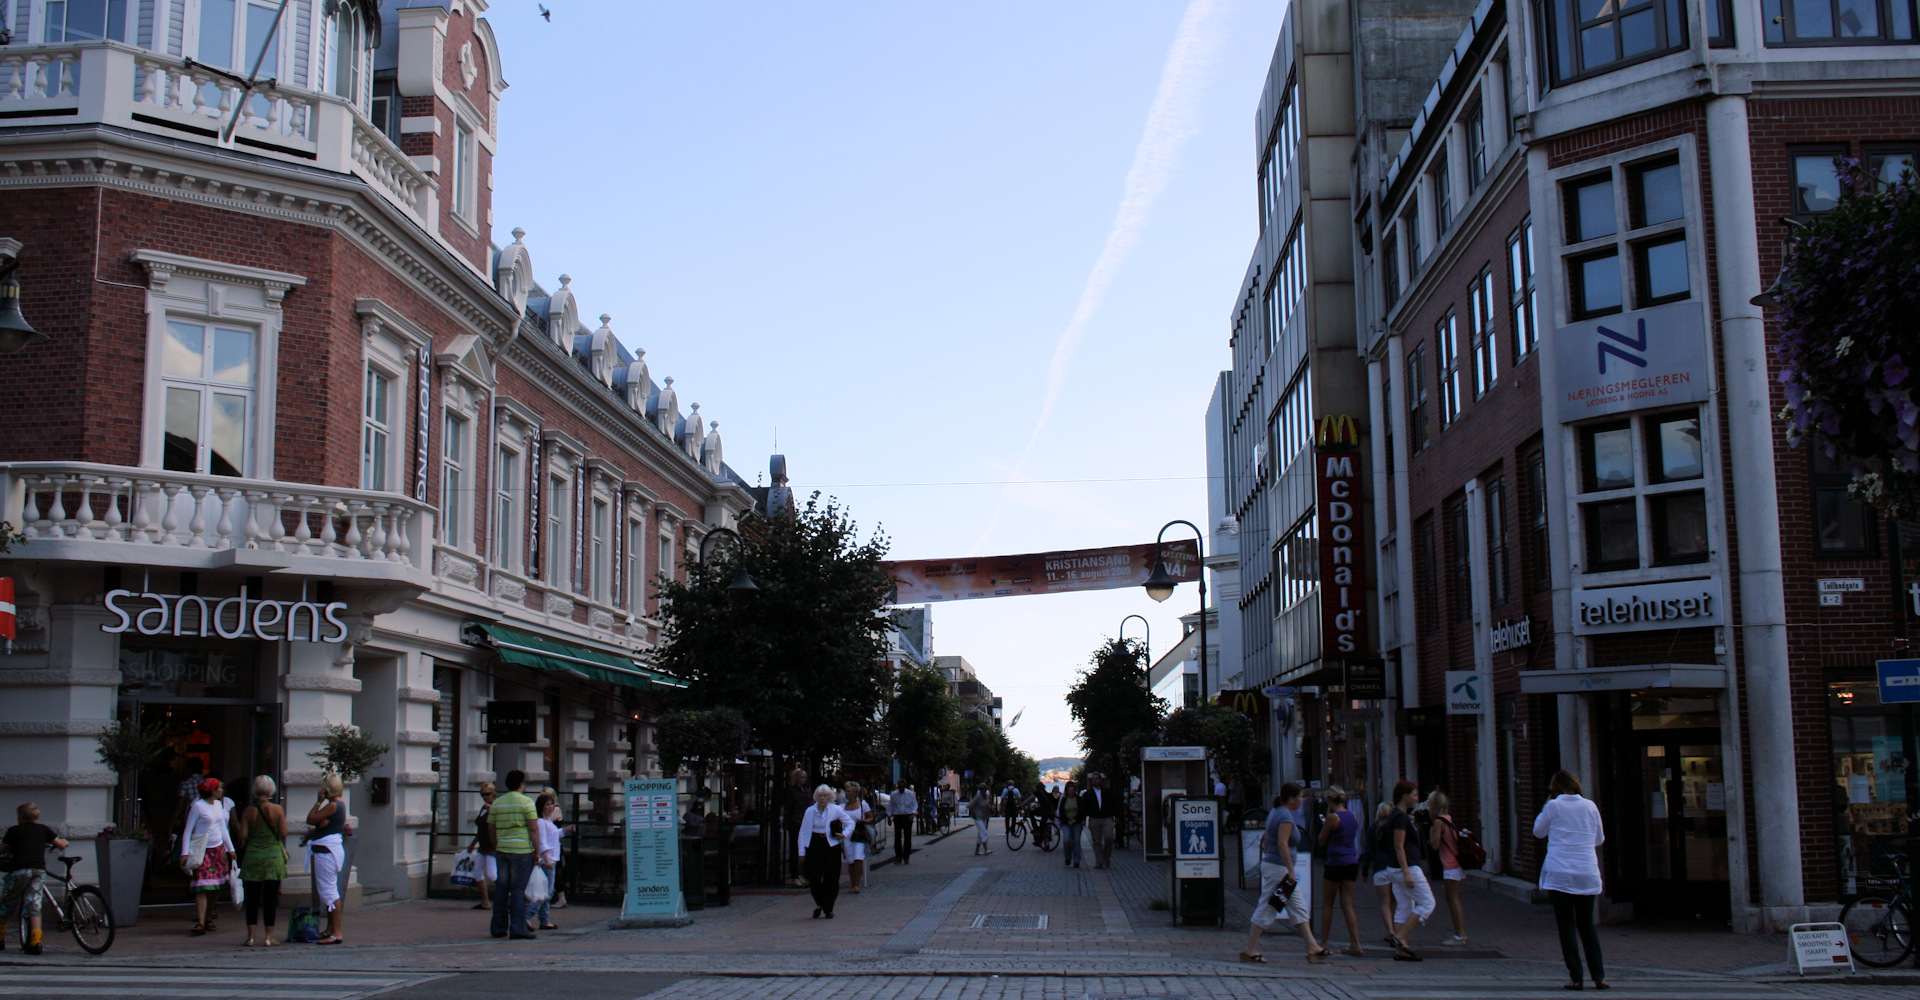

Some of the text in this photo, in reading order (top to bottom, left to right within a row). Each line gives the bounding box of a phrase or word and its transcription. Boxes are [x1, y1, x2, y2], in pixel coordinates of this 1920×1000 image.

[1567, 372, 1691, 402] NÆRINGSMEGLEREN
[1627, 389, 1656, 399] HODNE
[1657, 388, 1669, 396] AS
[416, 346, 430, 503] SHOPPING
[531, 428, 541, 552] SHOPPING
[1325, 456, 1361, 653] McDonald's
[1045, 554, 1130, 571] KRISTIANSAND
[1046, 572, 1059, 581] 11.
[1066, 571, 1079, 580] 16.
[1080, 568, 1109, 580] august
[1111, 566, 1132, 576] 2009
[1823, 582, 1859, 591] Tollbodgata
[101, 585, 349, 643] sandens
[1579, 591, 1714, 626] telehuset
[1489, 614, 1532, 654] telehuset
[129, 662, 237, 684] SHOPPING
[1350, 683, 1382, 691] CHANEL
[1451, 701, 1481, 710] telenor
[1167, 750, 1189, 758] telenor
[628, 782, 672, 792] SHOPPING
[1182, 803, 1211, 815] Sone
[1184, 820, 1209, 829] Gågate
[637, 884, 670, 894] sandens
[1797, 940, 1832, 948] SMOOTHIES
